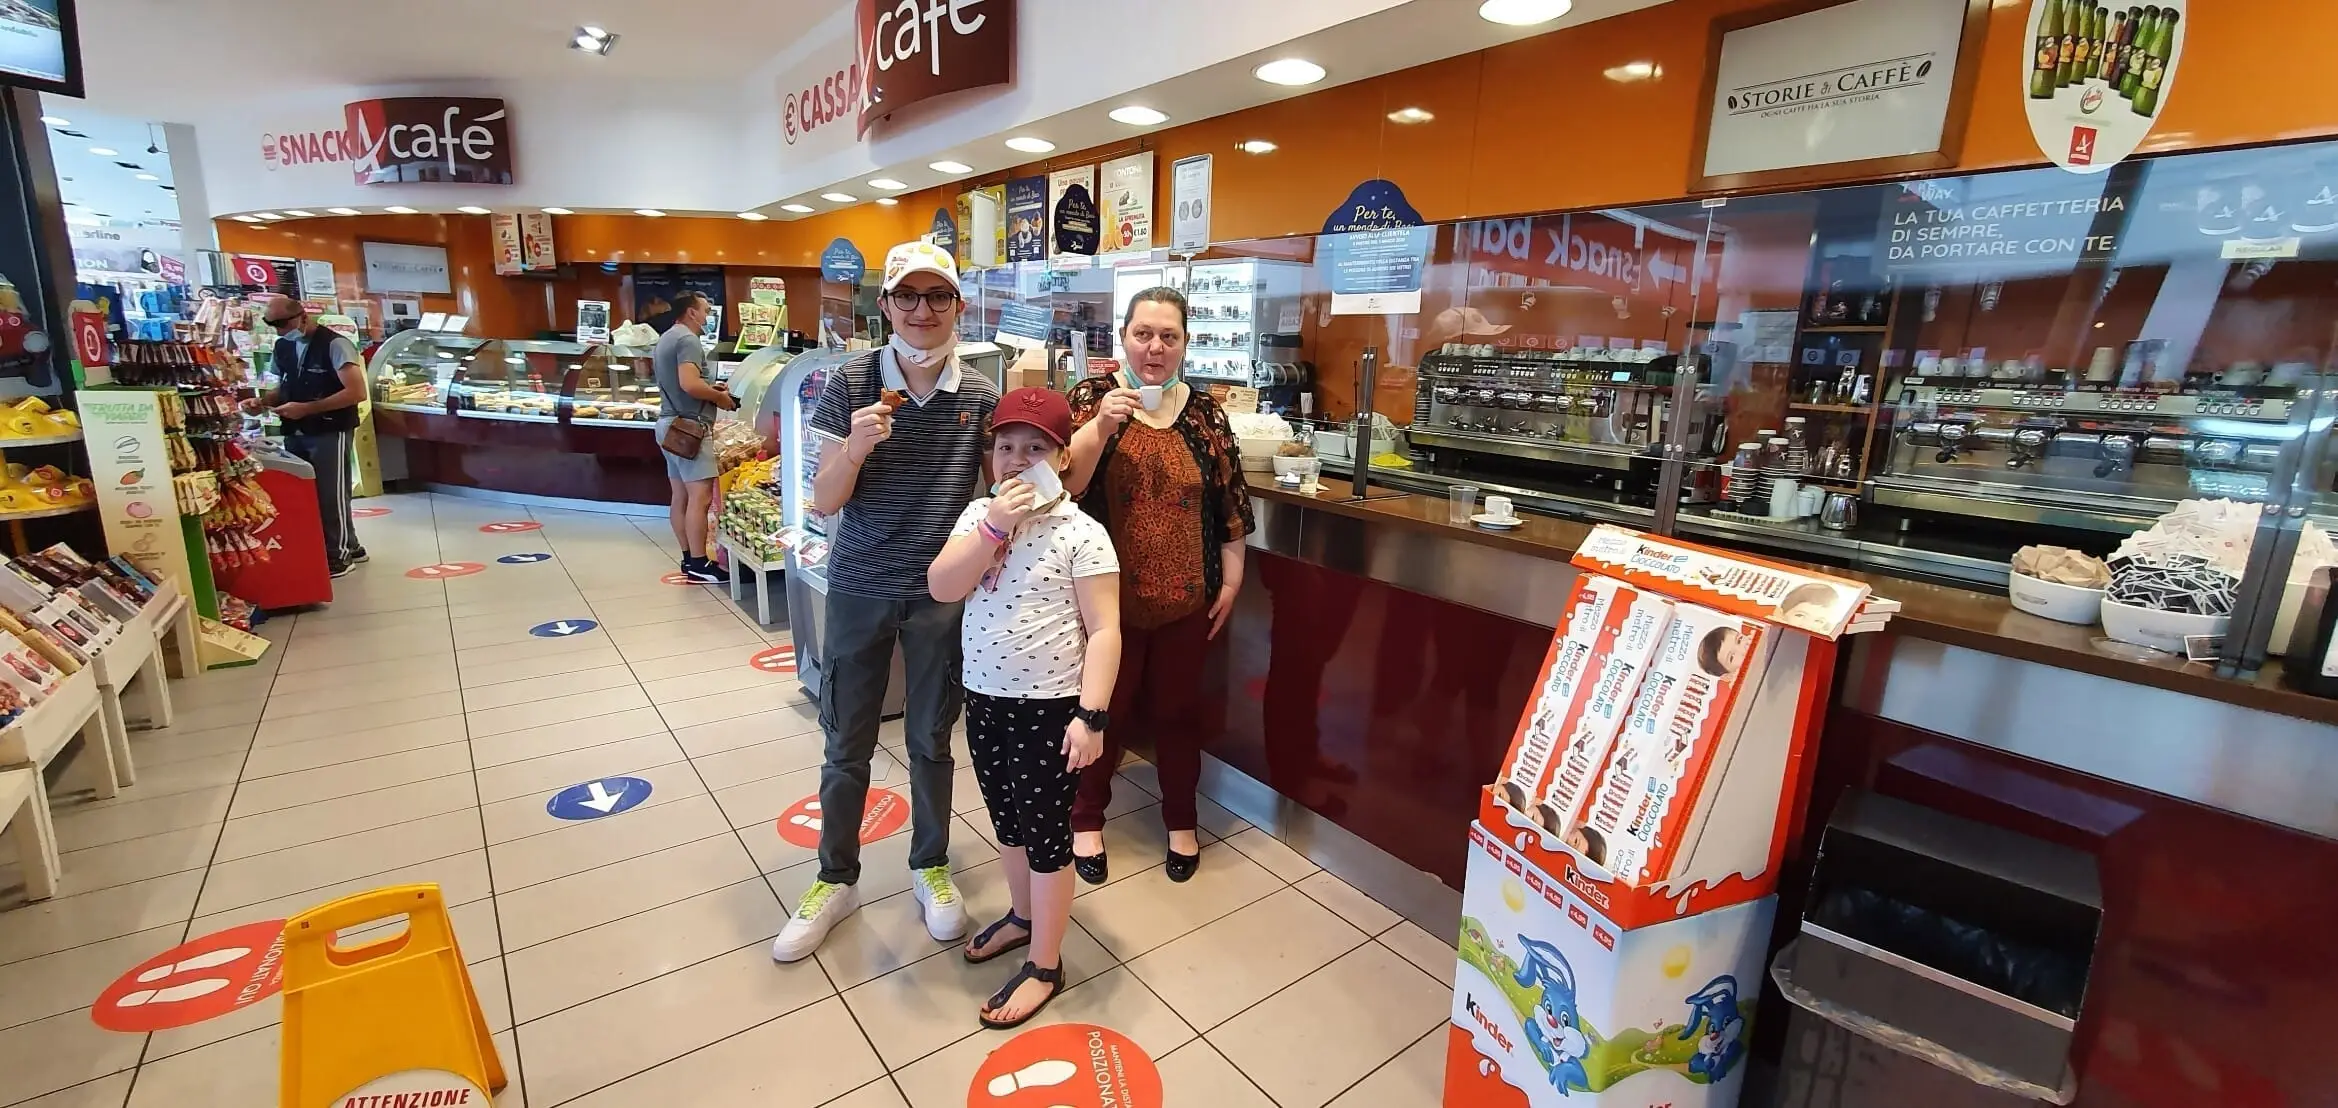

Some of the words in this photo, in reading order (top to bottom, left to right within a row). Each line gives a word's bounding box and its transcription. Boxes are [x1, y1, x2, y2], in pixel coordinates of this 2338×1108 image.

[800, 64, 859, 132] CASSA
[1741, 83, 1814, 109] STORIE
[1838, 62, 1912, 92] CAFFÈ
[279, 130, 352, 166] SNACK
[389, 106, 505, 176] café
[1354, 205, 1379, 222] Per
[1895, 212, 1918, 226] LA
[1926, 209, 1964, 223] TUA
[1972, 196, 2124, 222] CAFFETTERIA
[1888, 246, 1914, 260] DA
[1921, 240, 2019, 258] PORTARE
[2025, 238, 2076, 253] CON
[2084, 236, 2118, 252] TE.
[1891, 230, 1911, 243] DI
[1917, 223, 2004, 242] SEMPRE,
[234, 983, 262, 1005] QUI
[1110, 1045, 1124, 1077] MANTIENI
[1119, 1079, 1127, 1088] LA
[345, 1089, 471, 1108] ATTENZIONE
